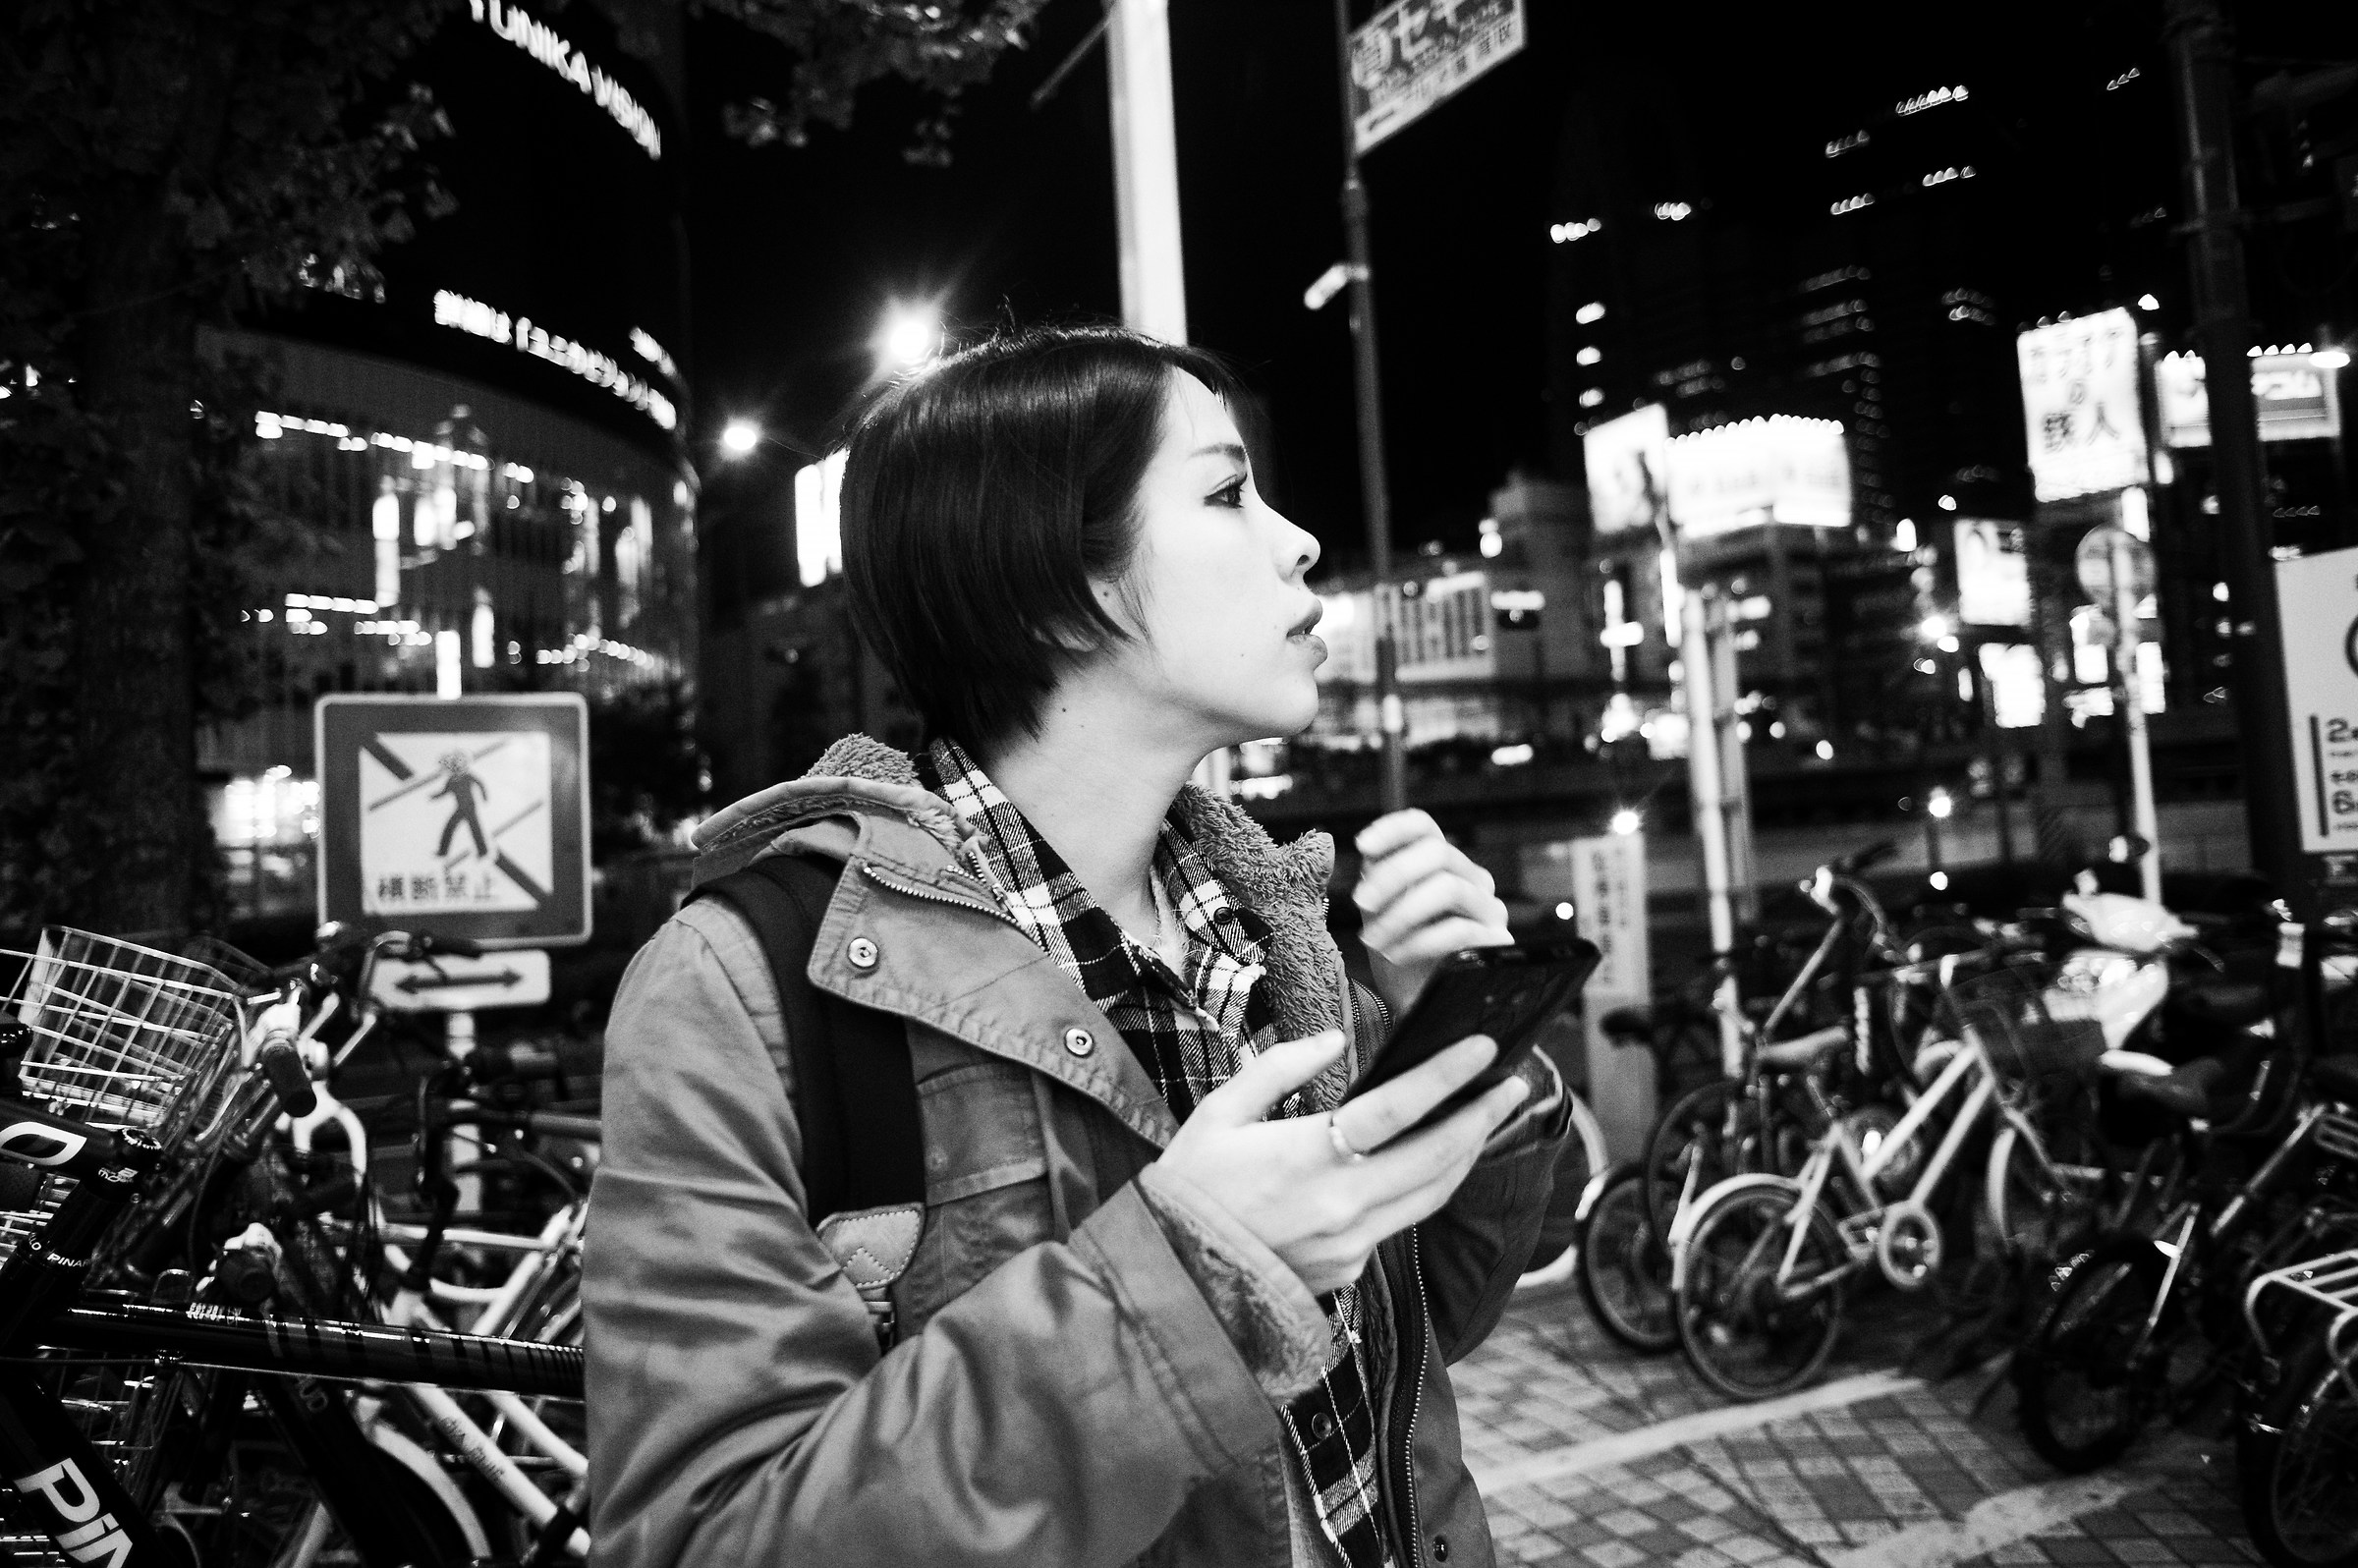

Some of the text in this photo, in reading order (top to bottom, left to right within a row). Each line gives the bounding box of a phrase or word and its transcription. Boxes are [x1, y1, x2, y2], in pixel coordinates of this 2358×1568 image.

[590, 64, 661, 160] VISION
[377, 873, 498, 901] 横断禁止
